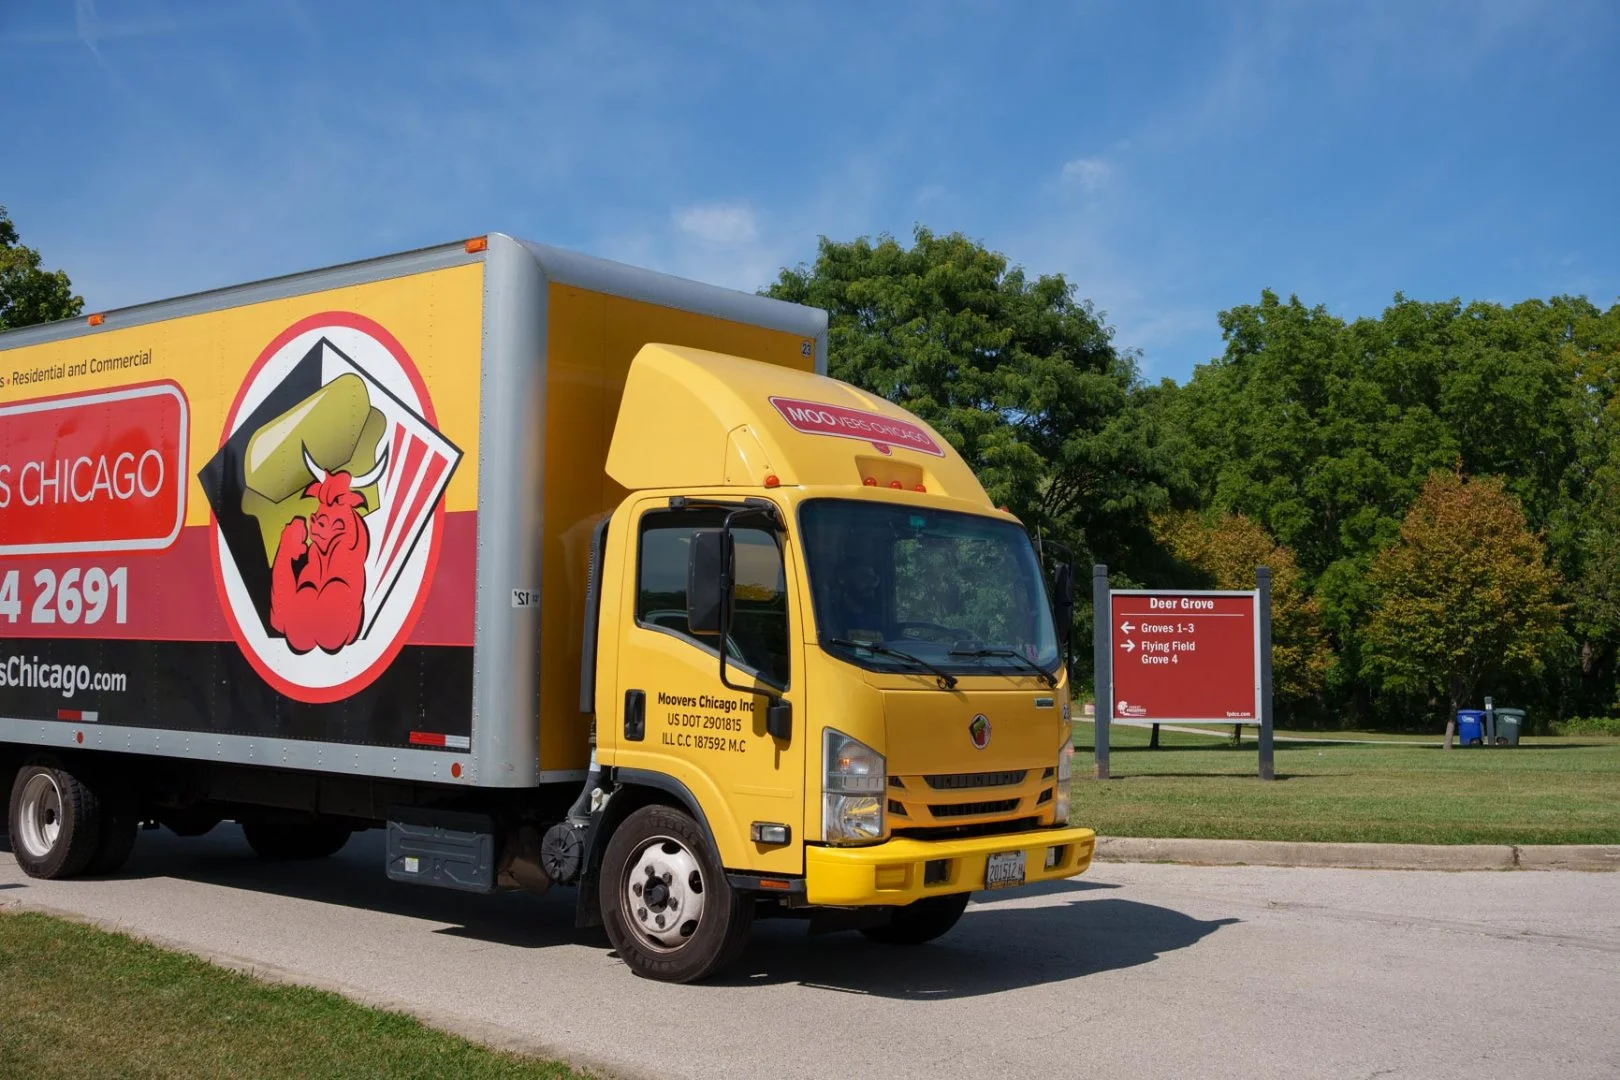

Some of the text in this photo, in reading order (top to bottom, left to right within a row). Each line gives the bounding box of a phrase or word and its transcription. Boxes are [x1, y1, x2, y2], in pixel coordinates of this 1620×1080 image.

[12, 363, 66, 386] Residential
[67, 359, 87, 377] and
[90, 348, 152, 374] Commercial
[787, 407, 931, 445] MOOVERS CHICAGO
[20, 449, 165, 507] CHICAGO
[31, 566, 128, 625] 2691
[1150, 597, 1214, 609] Deer Grove
[1141, 623, 1195, 633] Groves 1-3
[1141, 641, 1196, 653] Flying Field
[1141, 654, 1178, 664] Grove 4
[658, 692, 755, 713] Moovers Chicago Inc
[667, 713, 742, 732] US DOT 2901815
[662, 732, 746, 753] ILL C.C 187592 M.C
